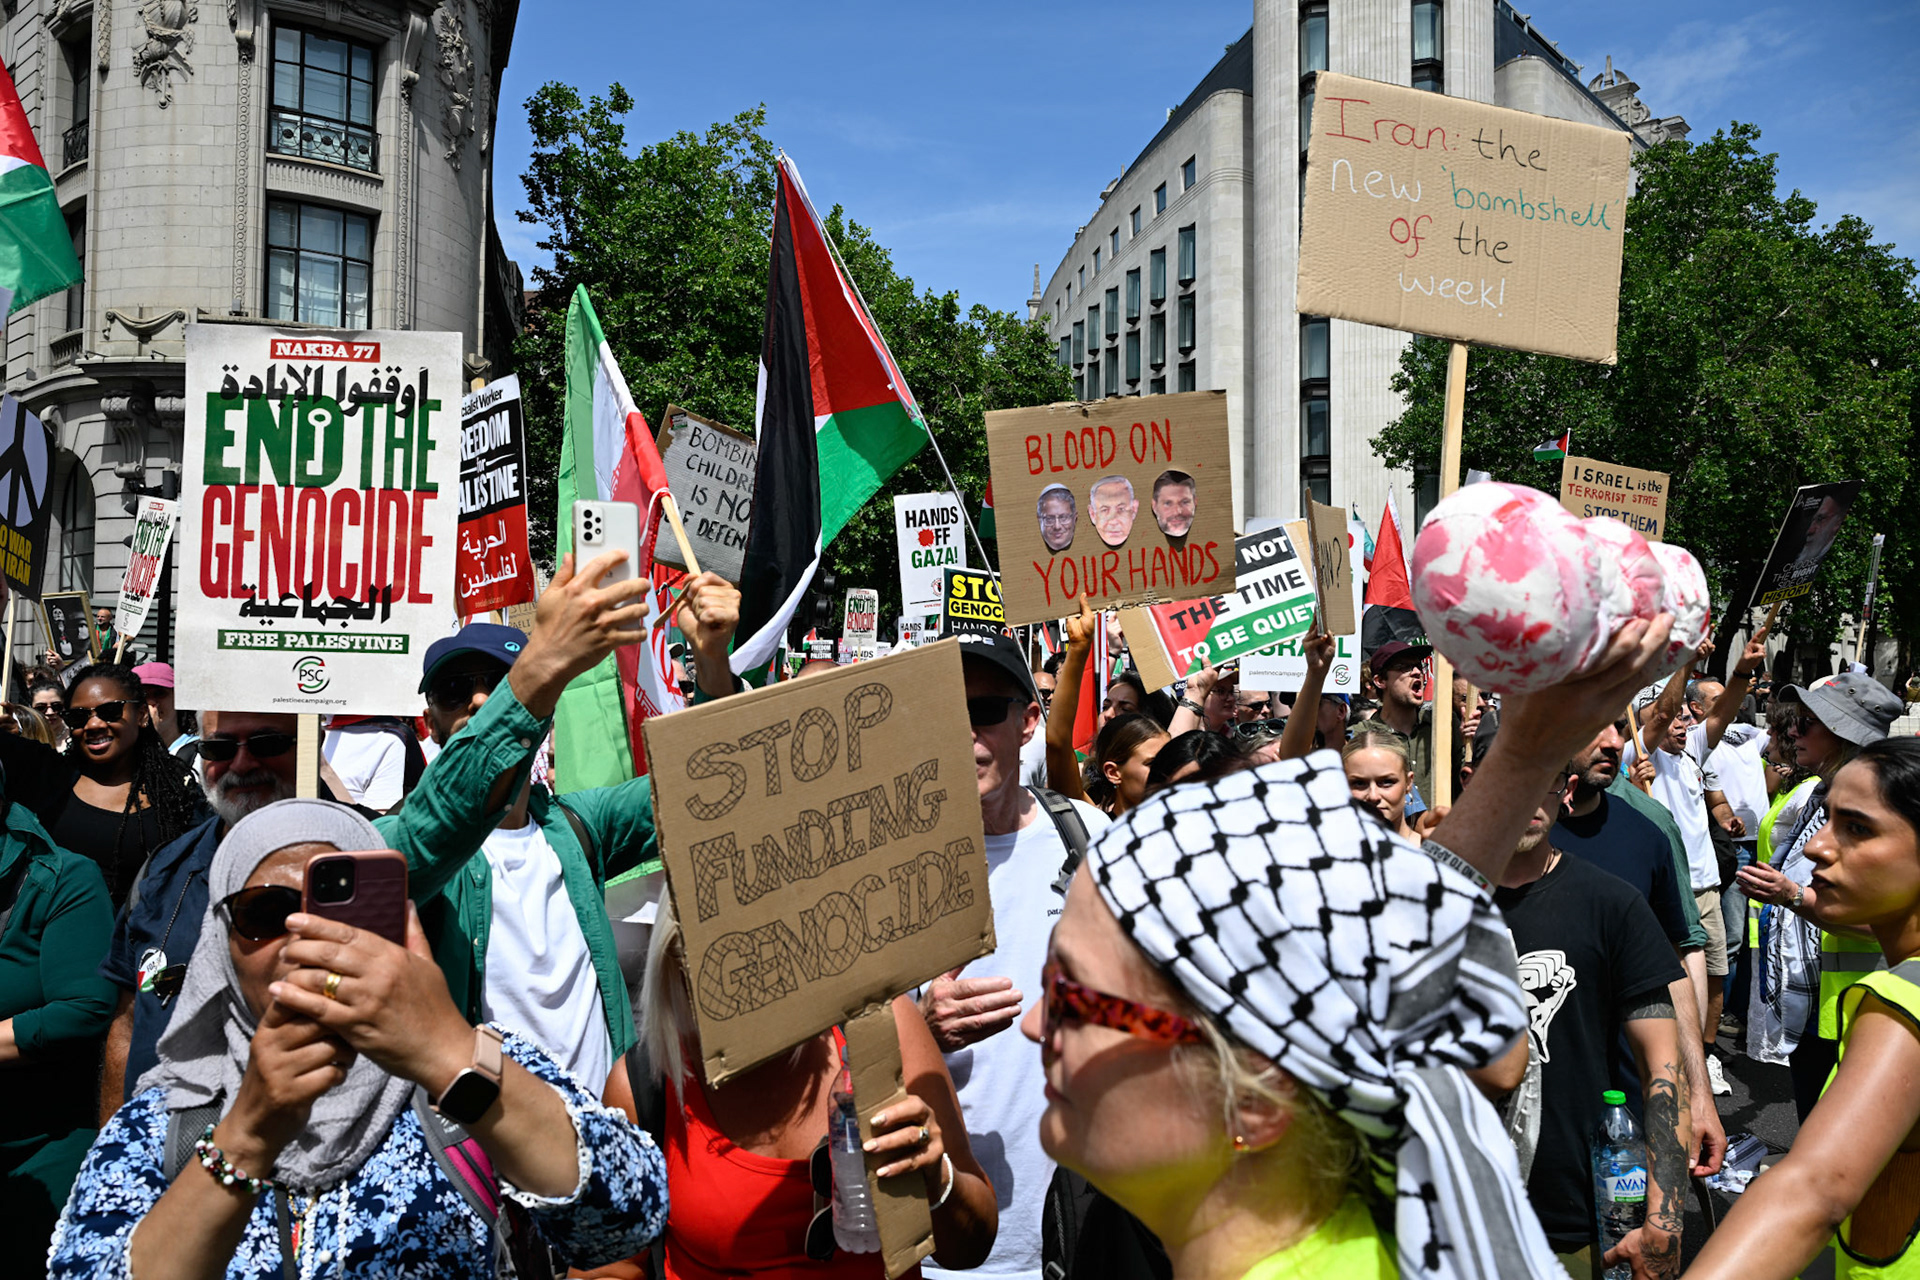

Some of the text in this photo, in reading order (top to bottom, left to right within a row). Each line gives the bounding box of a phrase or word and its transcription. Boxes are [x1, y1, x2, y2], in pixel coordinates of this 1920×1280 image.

[1324, 96, 1547, 171] Iran: the
[1331, 158, 1421, 202] new
[1453, 220, 1513, 263] the
[1399, 272, 1506, 317] week!
[275, 341, 376, 359] NAKBA 77
[478, 388, 504, 409] Worker
[203, 391, 441, 492] END THE
[460, 409, 512, 462] REEDOM
[689, 426, 757, 474] BOMBIN
[1025, 418, 1173, 476] BLOOD ON
[458, 462, 520, 514] ALESTINE
[690, 484, 708, 505] IS
[1567, 483, 1658, 507] TERRORIST STATE
[905, 506, 959, 528] HANDS
[1621, 511, 1658, 535] THEM
[9, 528, 32, 564] WAR
[199, 483, 438, 604] GENOCIDE
[462, 519, 507, 560] الحرية
[911, 547, 958, 569] GAZA!
[1240, 535, 1288, 564] NOT
[6, 551, 31, 587] IRAN
[460, 552, 518, 599] لفلسطين
[1032, 541, 1220, 608] YOUR HANDS
[1772, 564, 1819, 583] THE RIGHT
[1782, 557, 1819, 573] CHOOSE
[238, 581, 392, 629] الجماعية
[951, 574, 1003, 602] STO
[1169, 568, 1306, 631] THE TIME
[1763, 582, 1812, 603] HISTORY
[224, 631, 403, 651] FREE PALESTINE
[1177, 642, 1211, 666] TO
[1215, 625, 1250, 651] BE
[299, 668, 324, 682] PSC
[272, 696, 347, 705] palestinecampaign.org
[685, 682, 893, 820] STOP
[689, 758, 947, 923] FUNDING
[1449, 856, 1463, 871] TO
[1461, 865, 1476, 879] NO
[697, 836, 975, 1021] GENOCIDE
